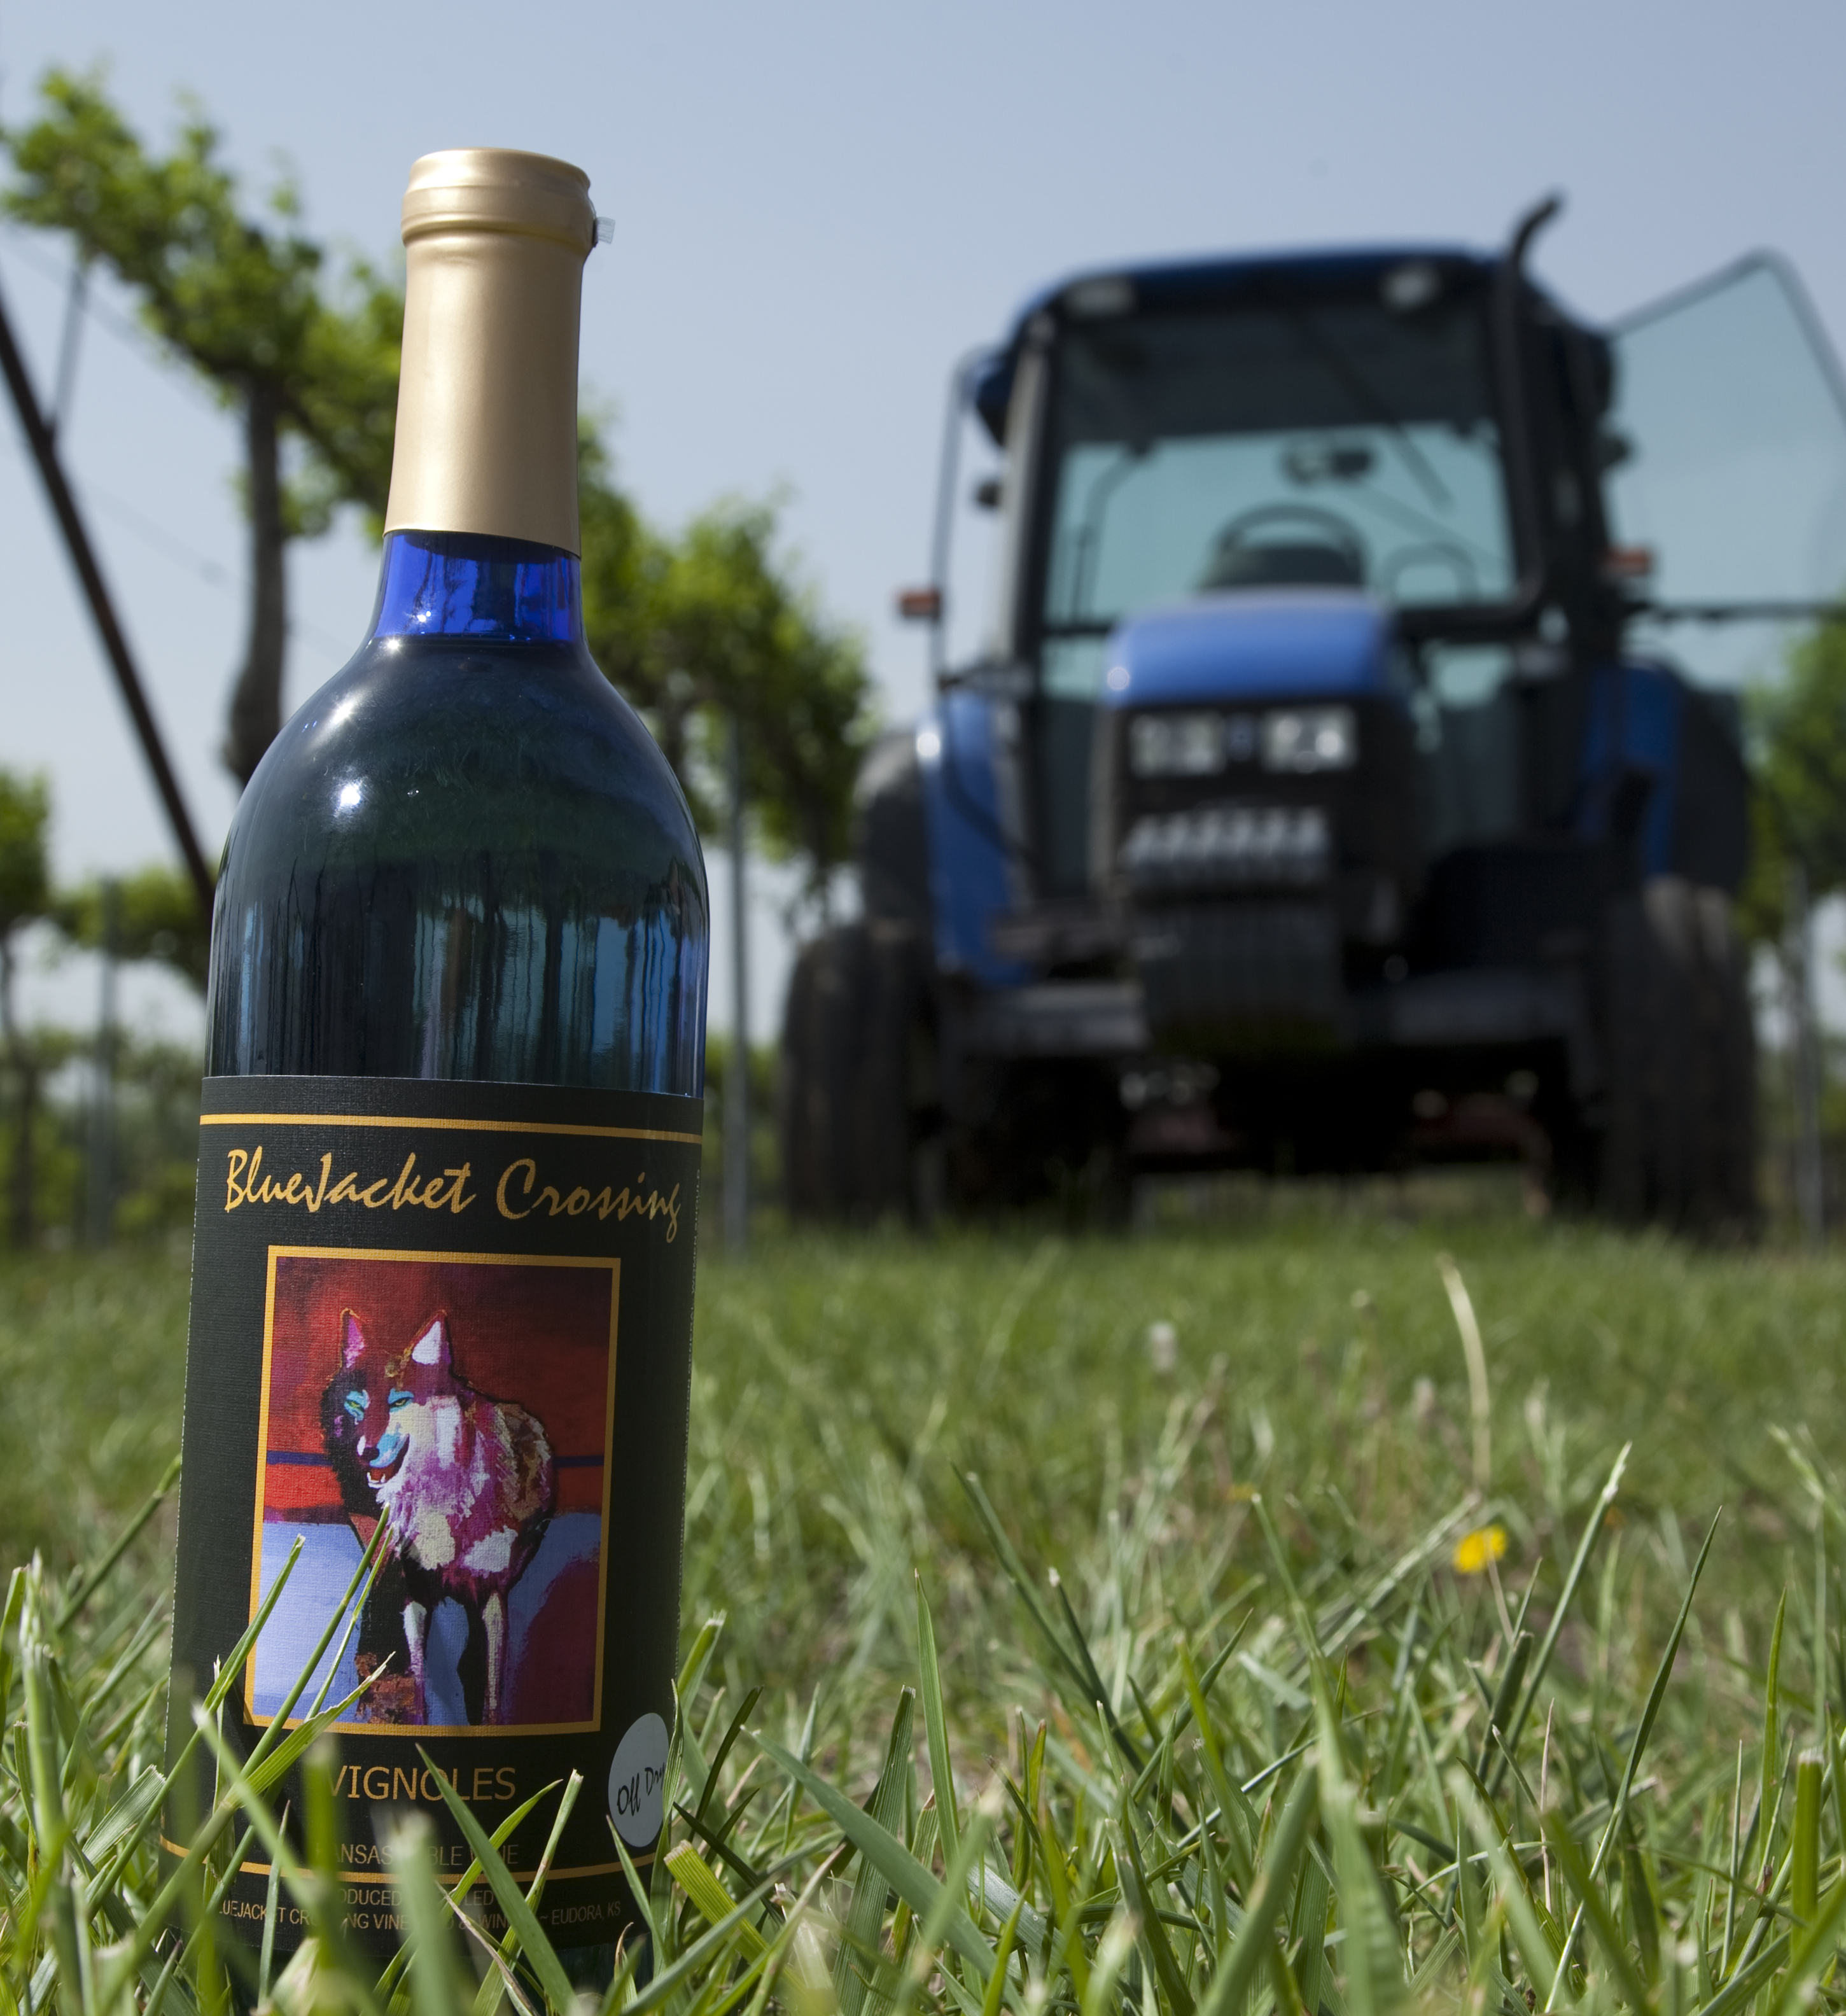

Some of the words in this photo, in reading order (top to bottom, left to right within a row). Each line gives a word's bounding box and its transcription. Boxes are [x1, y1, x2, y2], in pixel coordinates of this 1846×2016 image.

[225, 1145, 476, 1214] BlueJacket
[496, 1158, 681, 1243] Crossing
[326, 1765, 516, 1801] VIGNOLES
[617, 1772, 641, 1817] Off
[608, 1901, 621, 1917] KS
